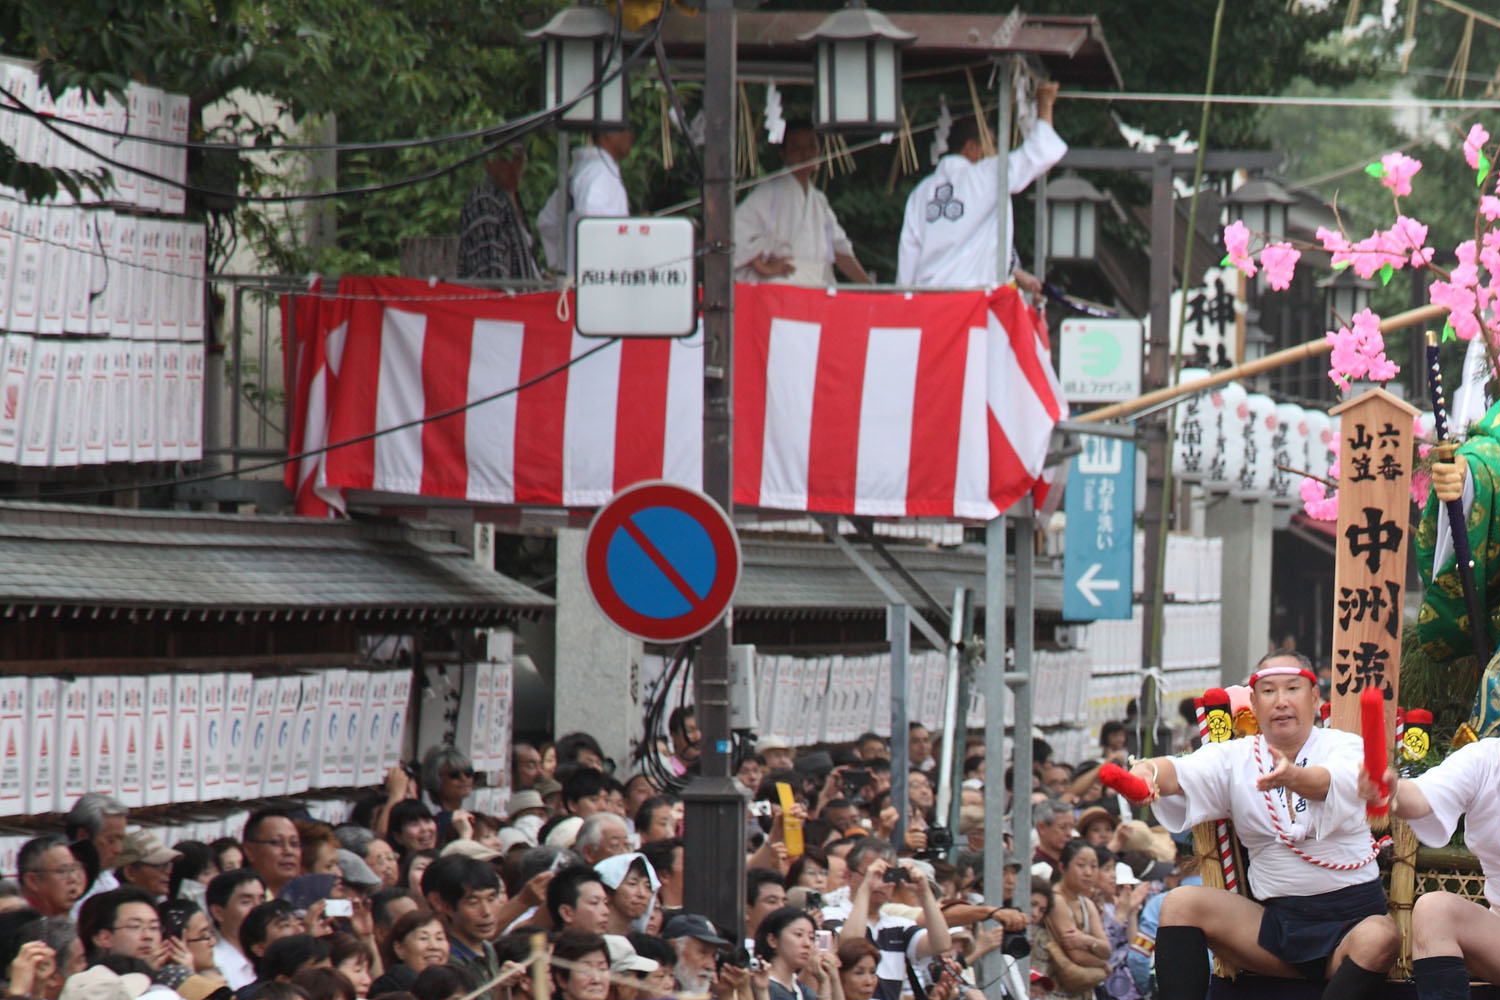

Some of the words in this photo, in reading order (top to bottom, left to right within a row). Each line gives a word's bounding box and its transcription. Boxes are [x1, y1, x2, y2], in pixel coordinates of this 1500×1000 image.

[1348, 423, 1377, 483] 山笠
[1377, 423, 1404, 482] 六番
[1097, 477, 1115, 551] お手洗い
[1336, 507, 1404, 701] 中洲流
